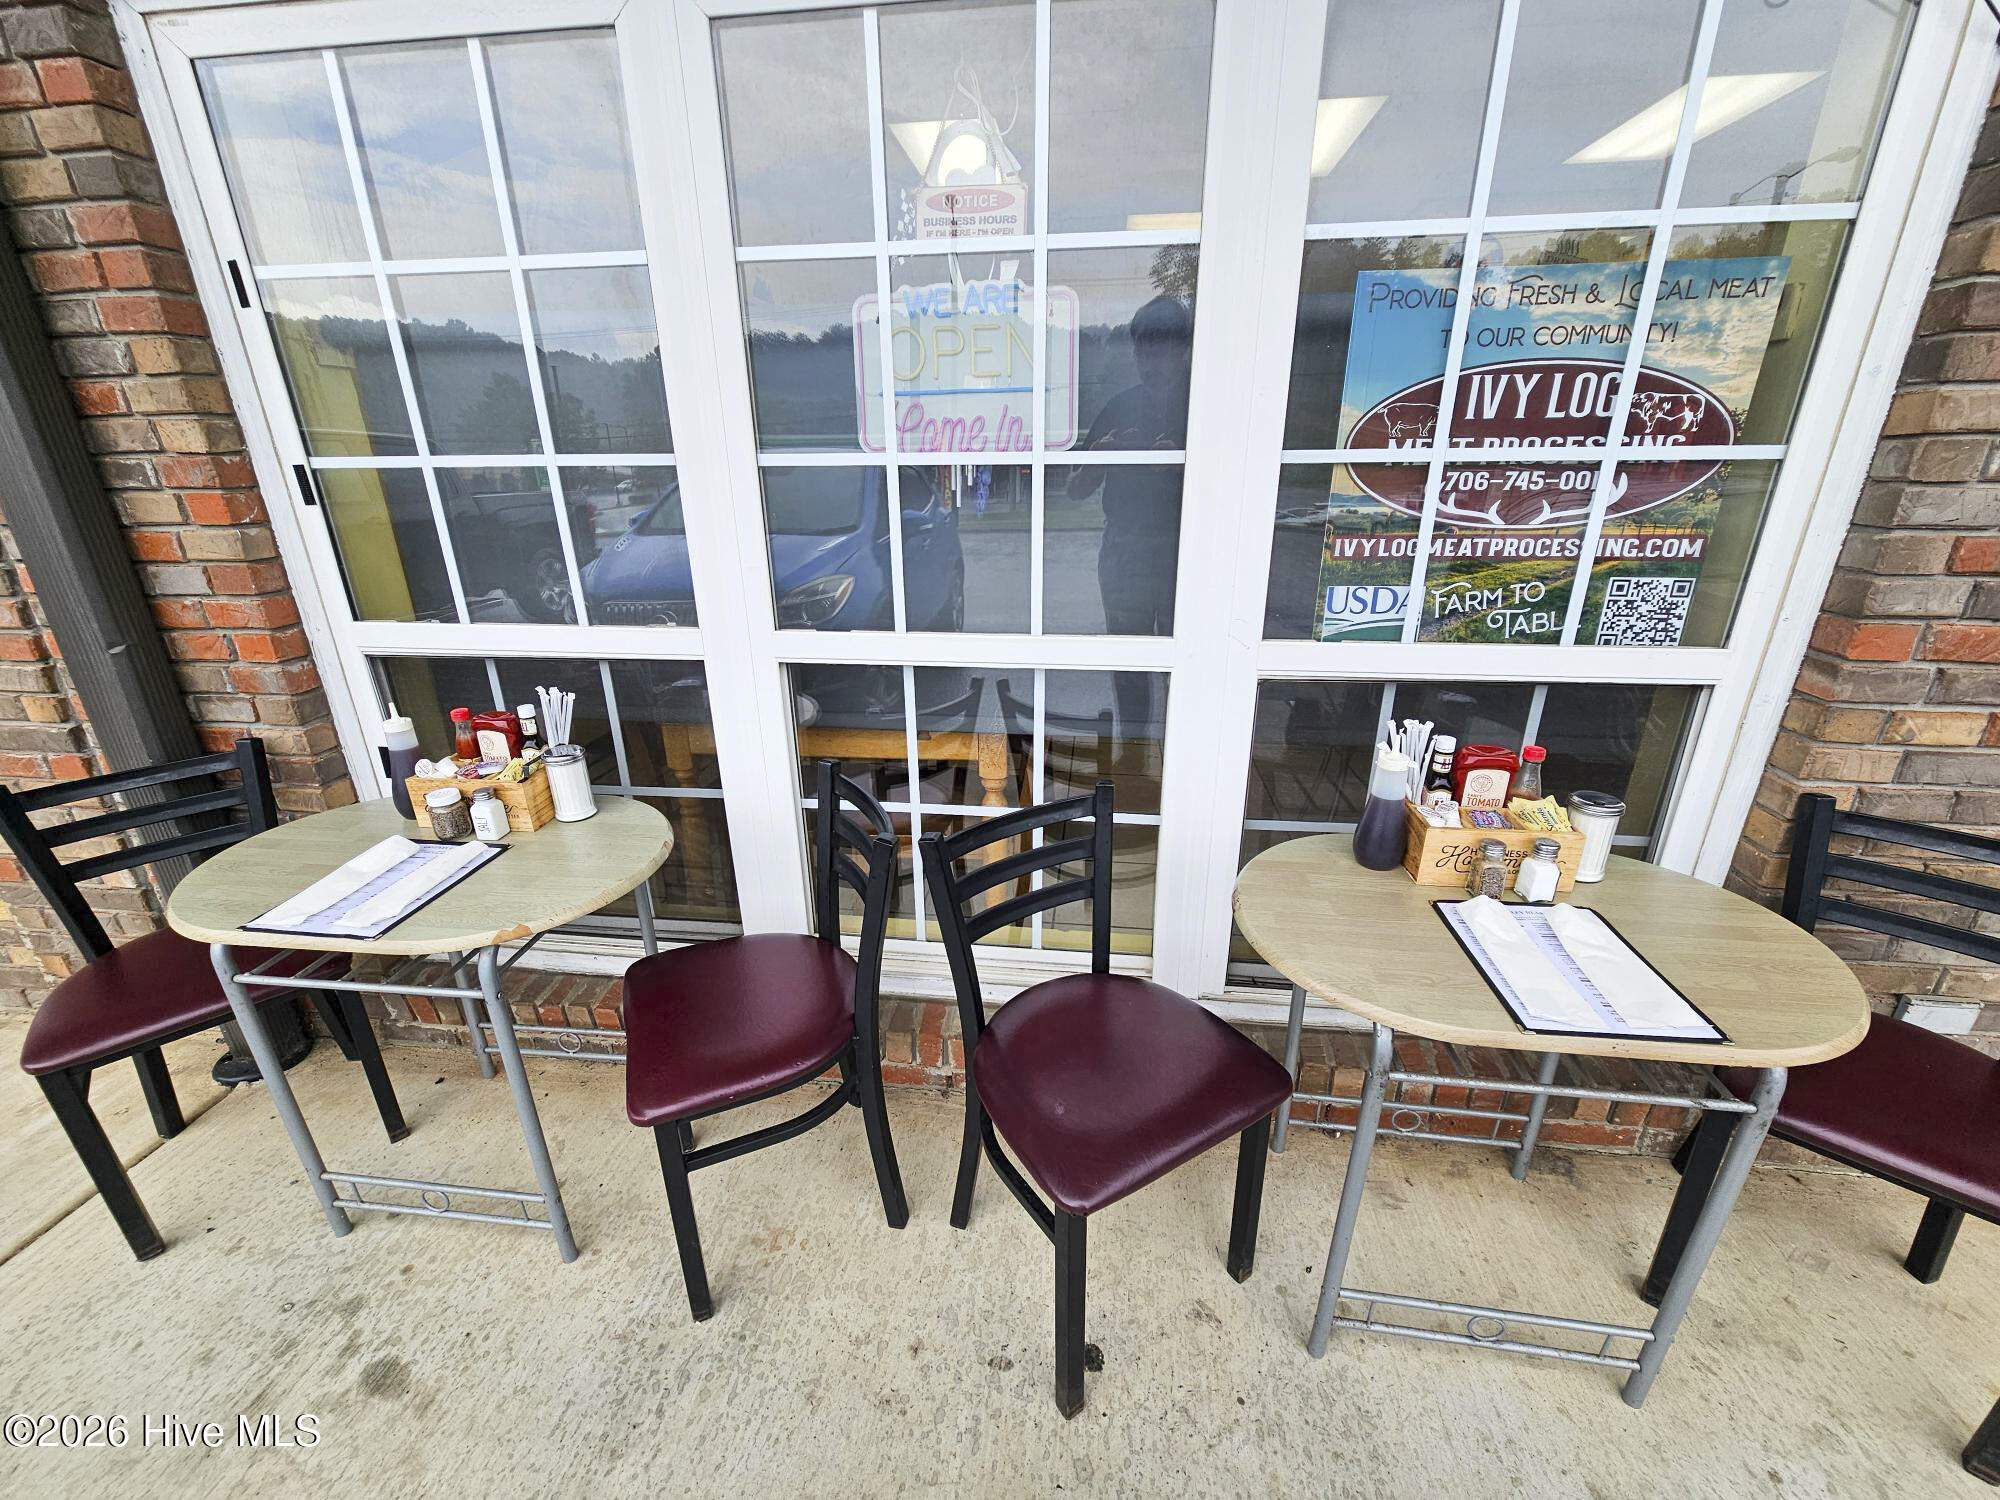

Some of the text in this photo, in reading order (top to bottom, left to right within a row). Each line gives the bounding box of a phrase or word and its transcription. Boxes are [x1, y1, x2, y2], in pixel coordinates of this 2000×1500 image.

[942, 194, 998, 208] NOTICE
[923, 214, 1018, 227] BUSINESS HOURS
[926, 229, 934, 238] IF
[948, 228, 971, 237] HERE
[990, 227, 1015, 236] OPEN
[902, 282, 1020, 319] WE ARE
[1369, 282, 1497, 313] PROVIDNG
[1585, 282, 1606, 304] &
[1708, 276, 1777, 299] MEAT
[1441, 321, 1679, 349] T OUR COMMUNTY!
[891, 322, 1034, 382] OPEN
[1464, 371, 1623, 420] IVY LOG
[1333, 537, 1704, 557] IVYLOGMEATPROCESING.COM
[1431, 581, 1545, 618] FARM TO
[1487, 607, 1581, 639] TABL
[1466, 796, 1500, 807] TOMATO
